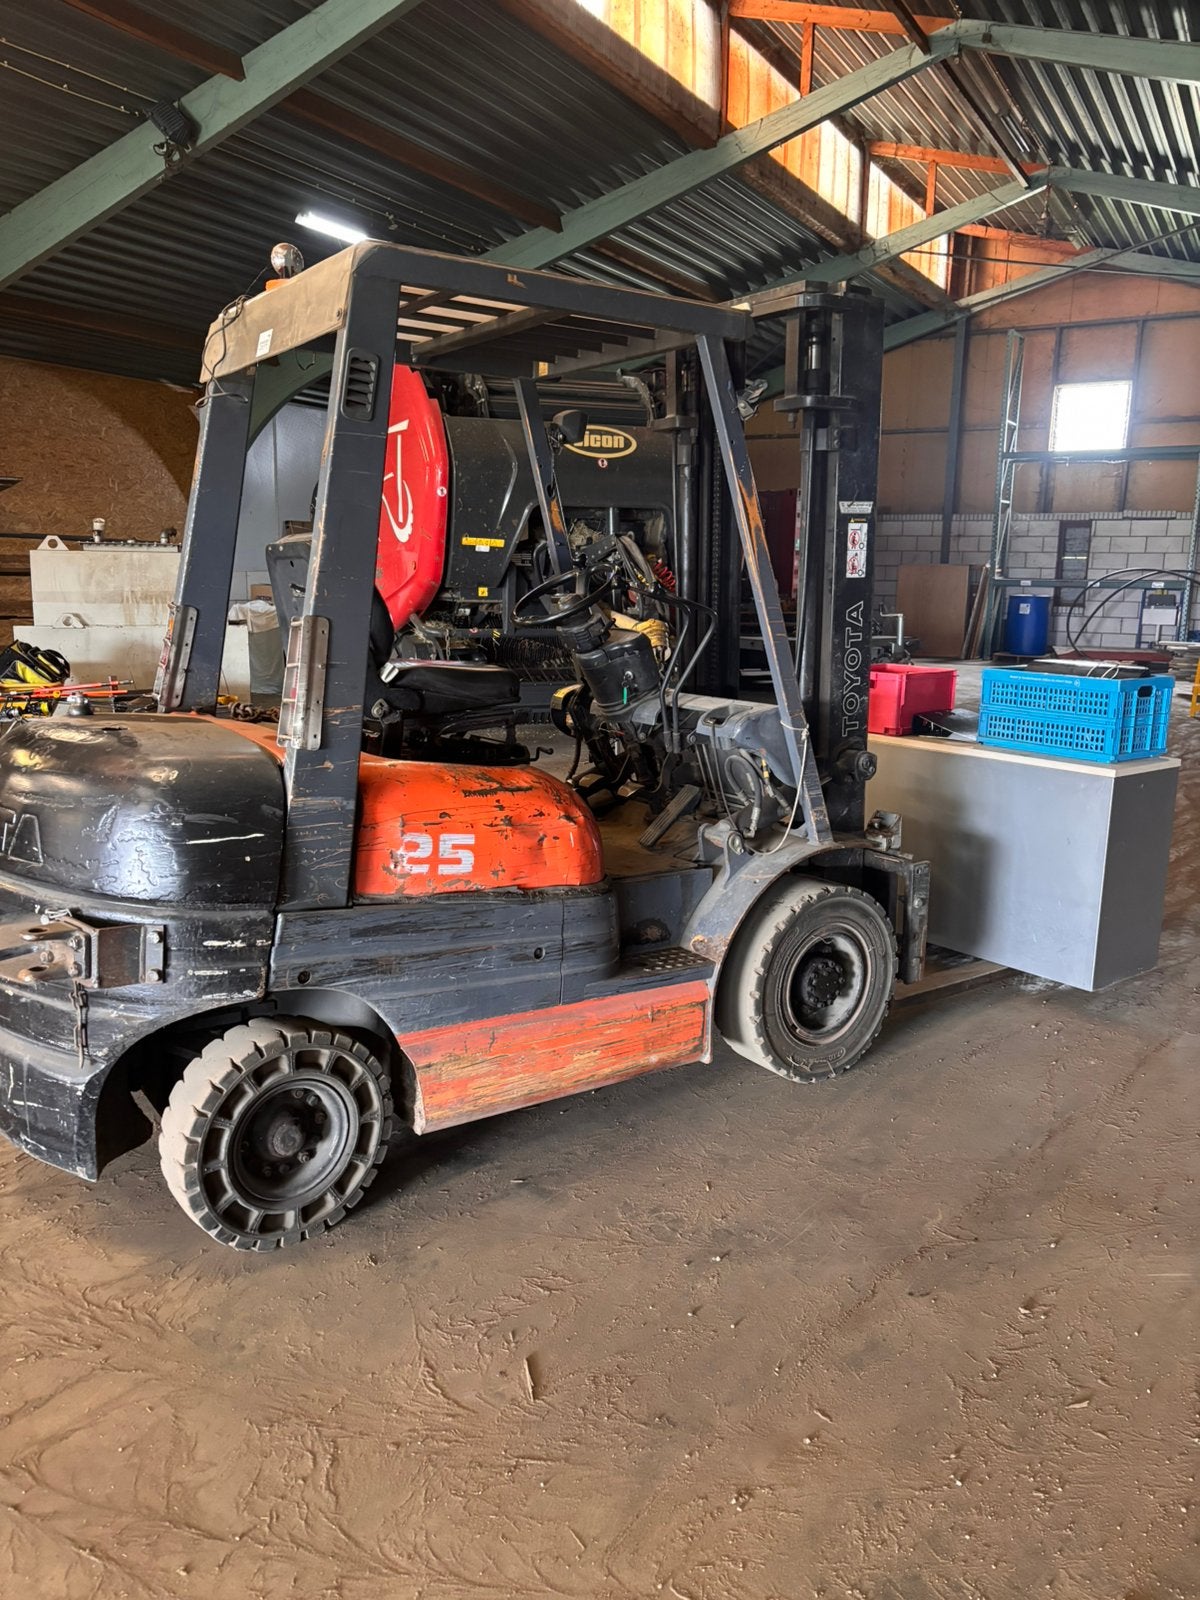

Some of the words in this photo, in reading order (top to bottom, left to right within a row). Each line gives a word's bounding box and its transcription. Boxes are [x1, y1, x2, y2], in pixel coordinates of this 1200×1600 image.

[573, 430, 624, 448] icon
[842, 600, 863, 737] TOYOTA
[391, 832, 475, 875] 25
